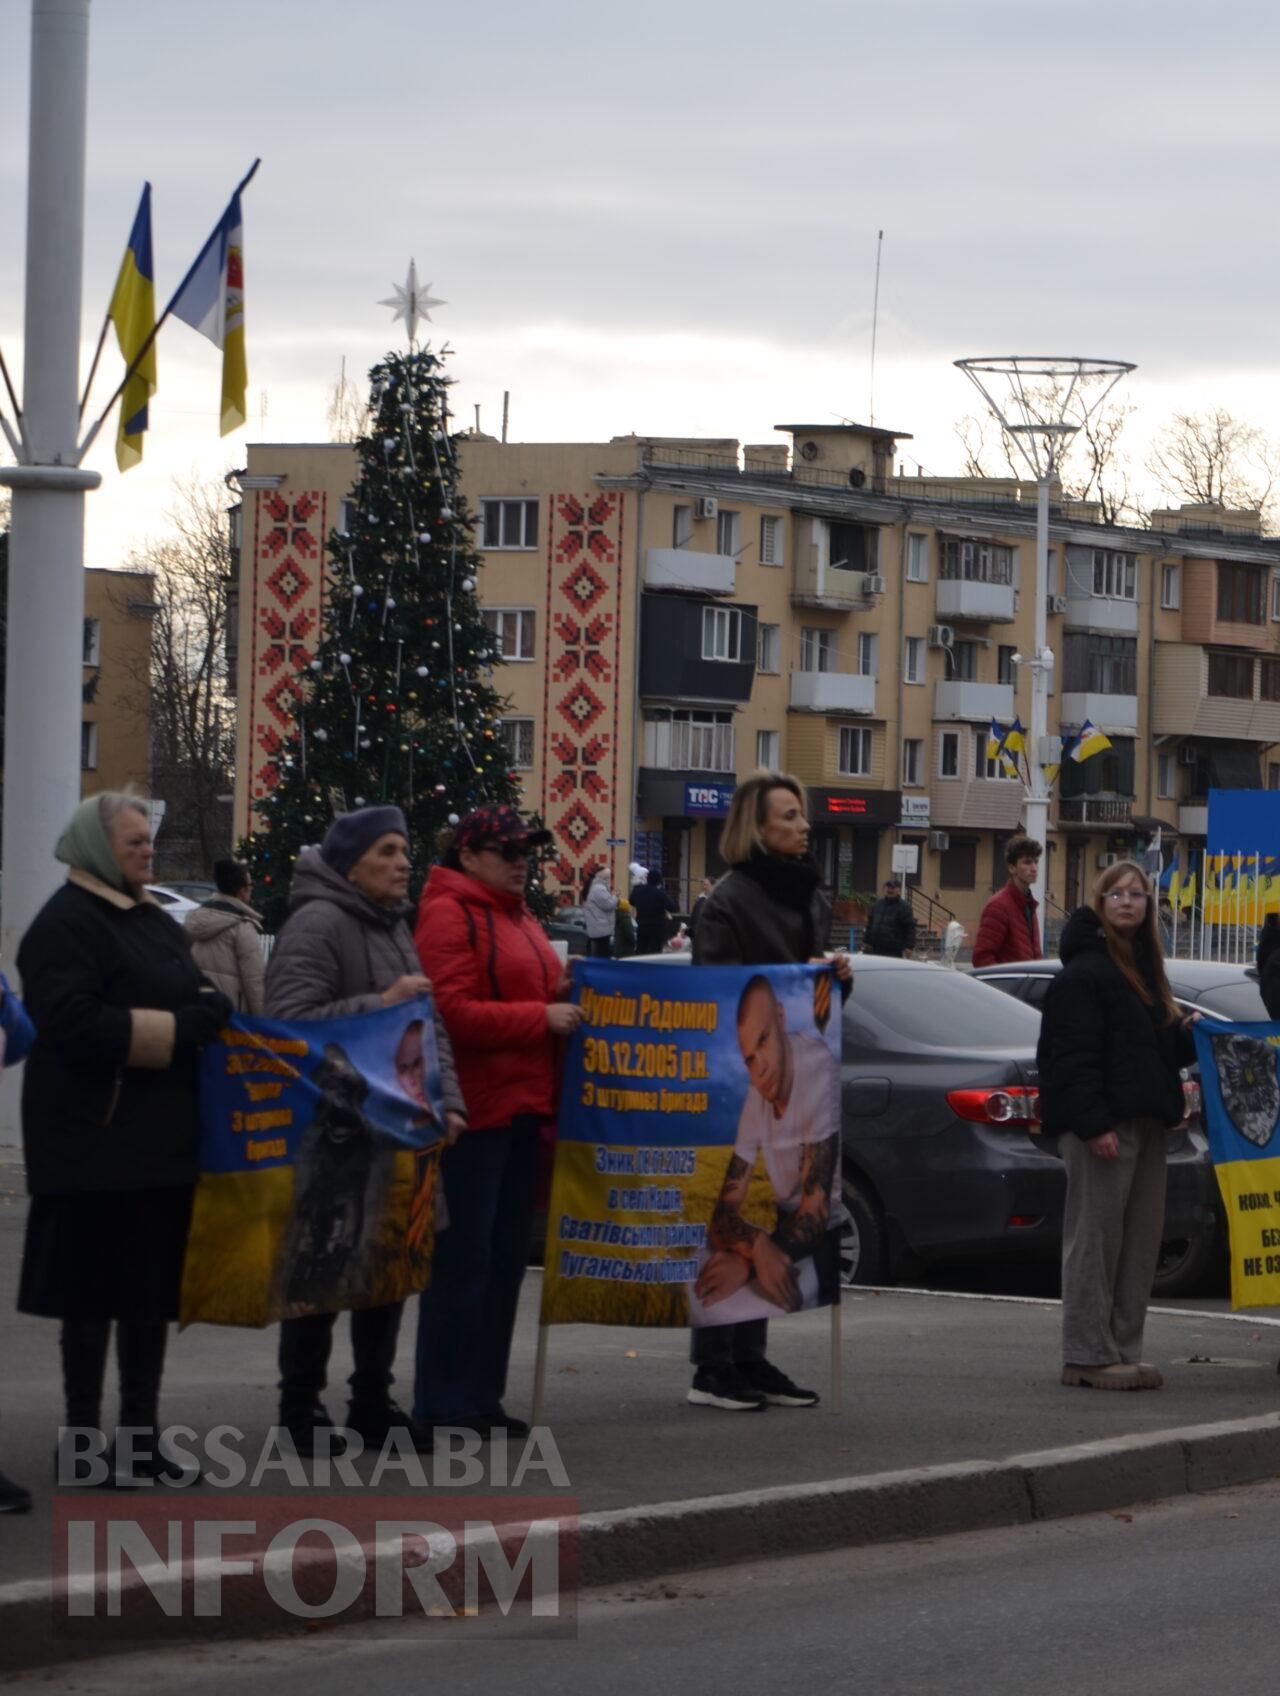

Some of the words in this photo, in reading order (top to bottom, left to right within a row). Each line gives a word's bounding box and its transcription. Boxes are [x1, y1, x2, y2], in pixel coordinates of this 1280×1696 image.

[639, 993, 719, 1034] Радомир
[583, 1037, 678, 1079] 30.12.2005
[681, 1050, 710, 1081] р.н.
[582, 1081, 595, 1106] 3
[595, 1146, 634, 1174] Зник
[560, 1250, 658, 1282] Луганської
[1244, 1256, 1263, 1277] НЕ
